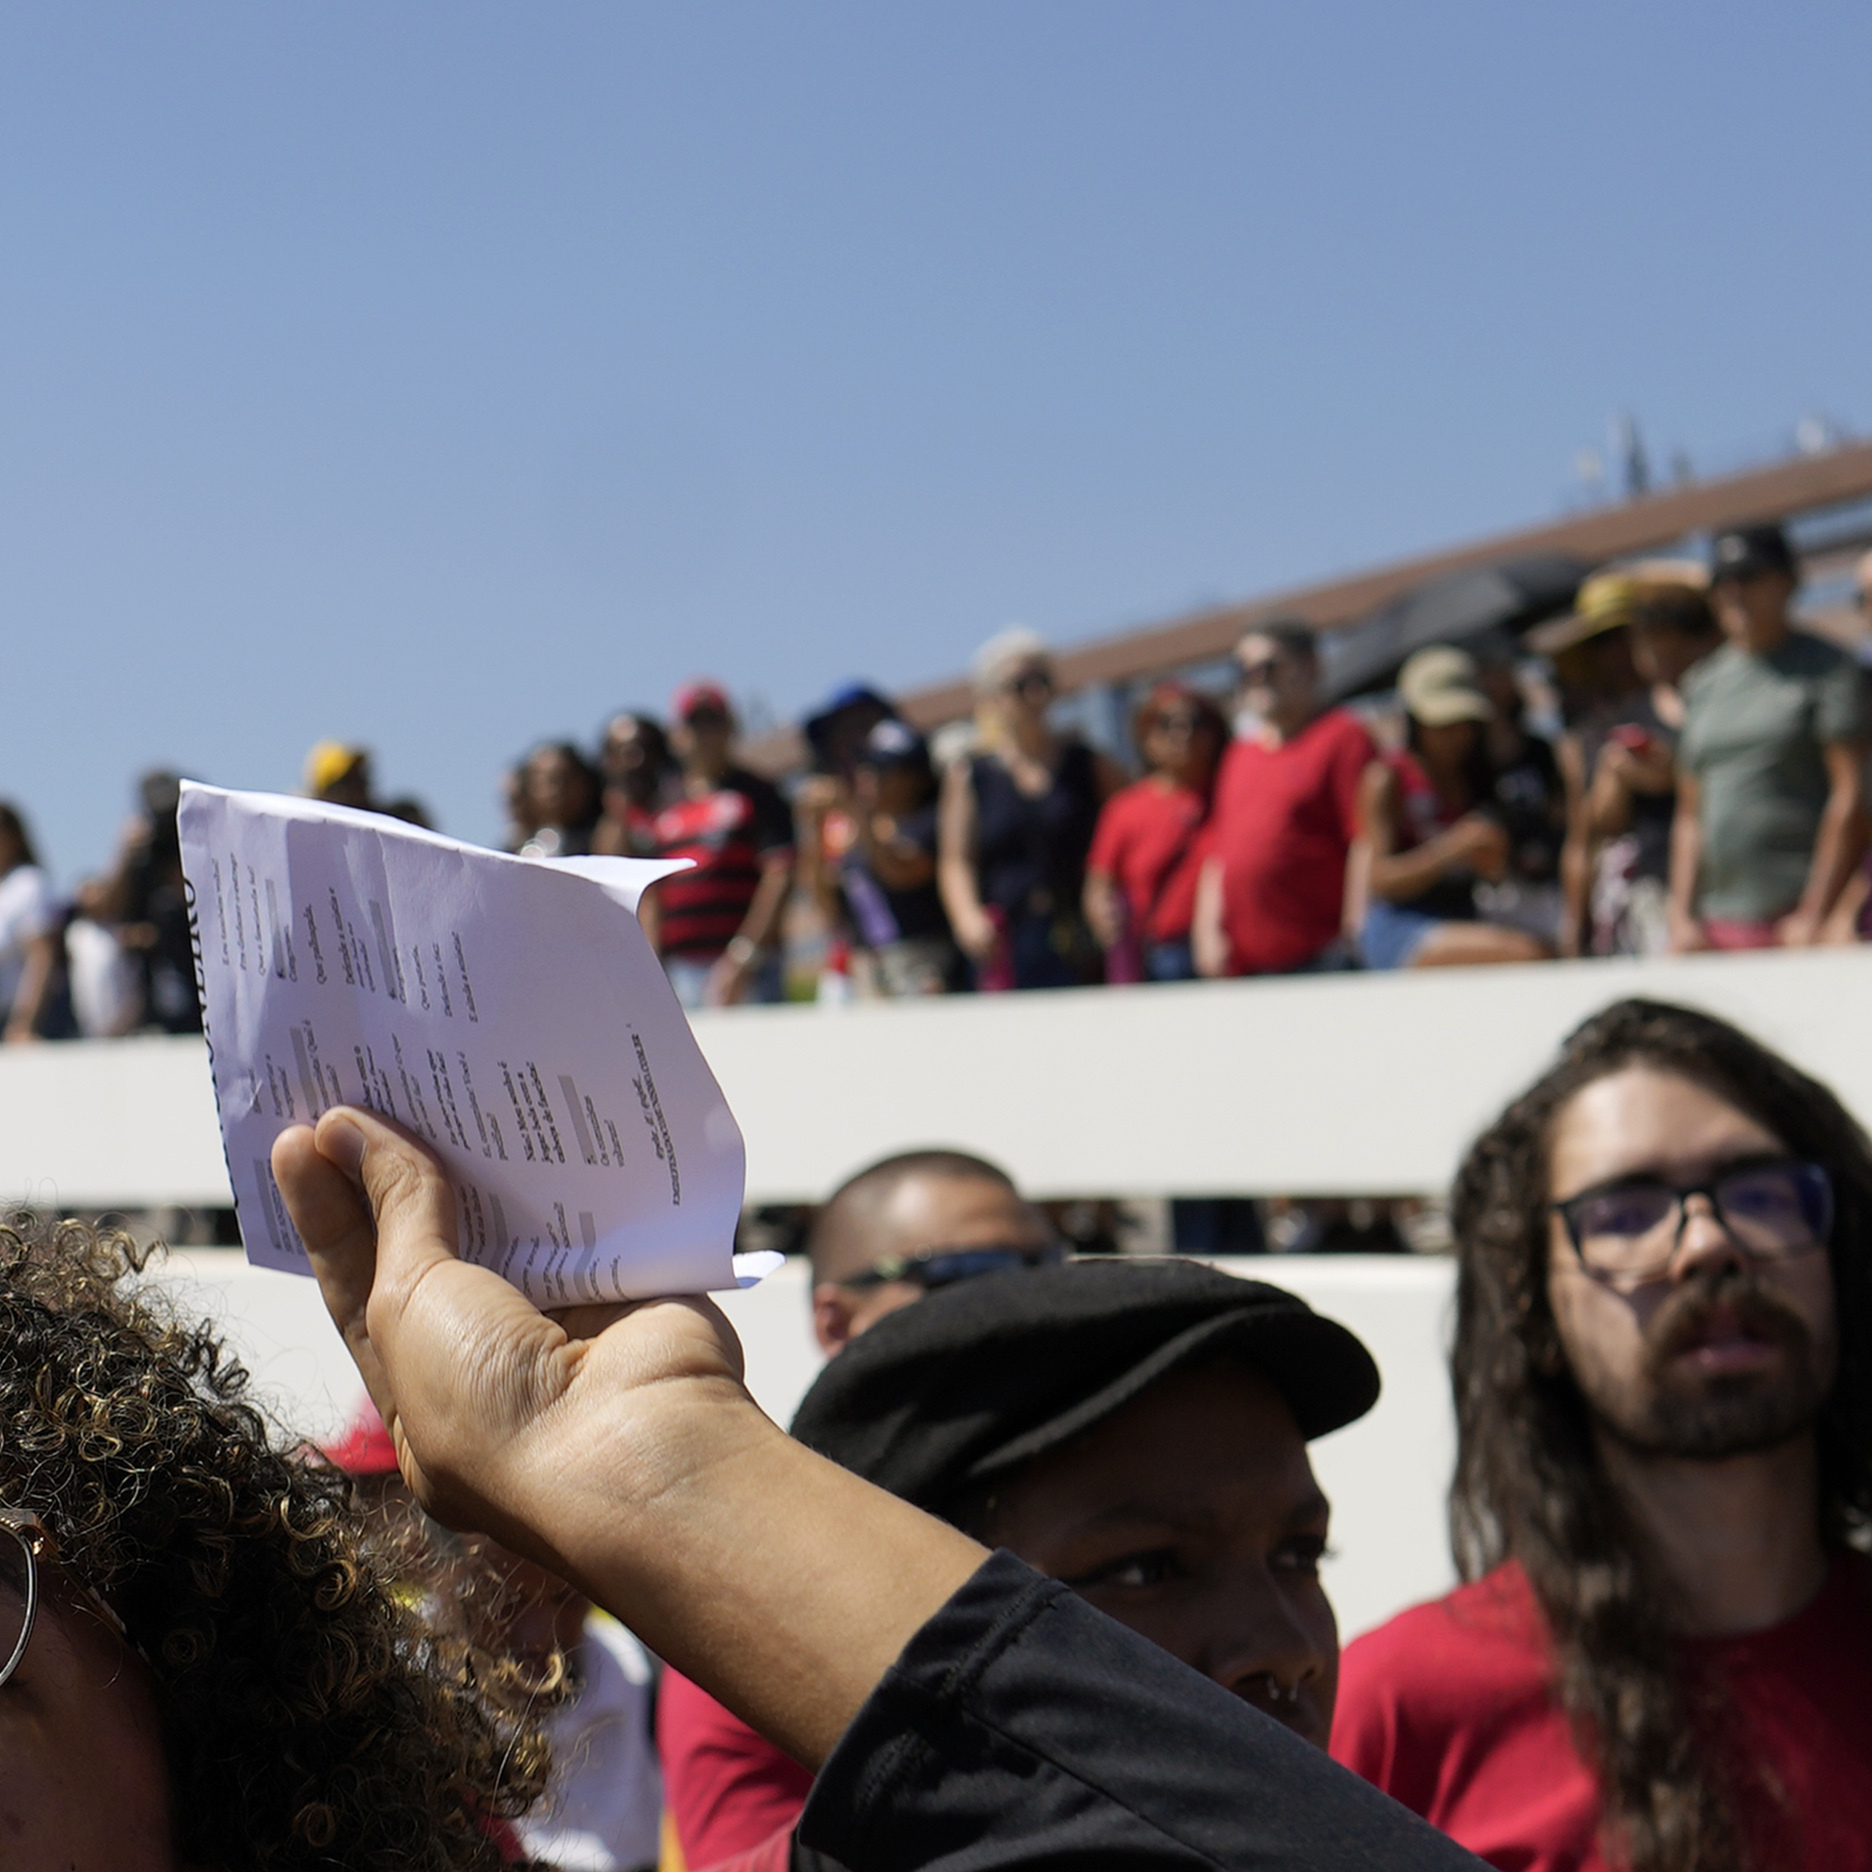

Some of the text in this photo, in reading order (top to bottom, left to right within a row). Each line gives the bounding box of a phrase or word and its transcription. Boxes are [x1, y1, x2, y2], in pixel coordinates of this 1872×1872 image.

[316, 962, 328, 985] Que
[338, 941, 355, 985] Defende
[421, 988, 430, 1011] Que
[437, 973, 453, 1017] Defende
[503, 1070, 519, 1106] sonho
[517, 1072, 524, 1080] a
[520, 1082, 533, 1106] com
[515, 1107, 528, 1132] Meu
[527, 1107, 542, 1131] bola
[542, 1109, 554, 1124] de
[584, 1095, 610, 1167] Os comunistas
